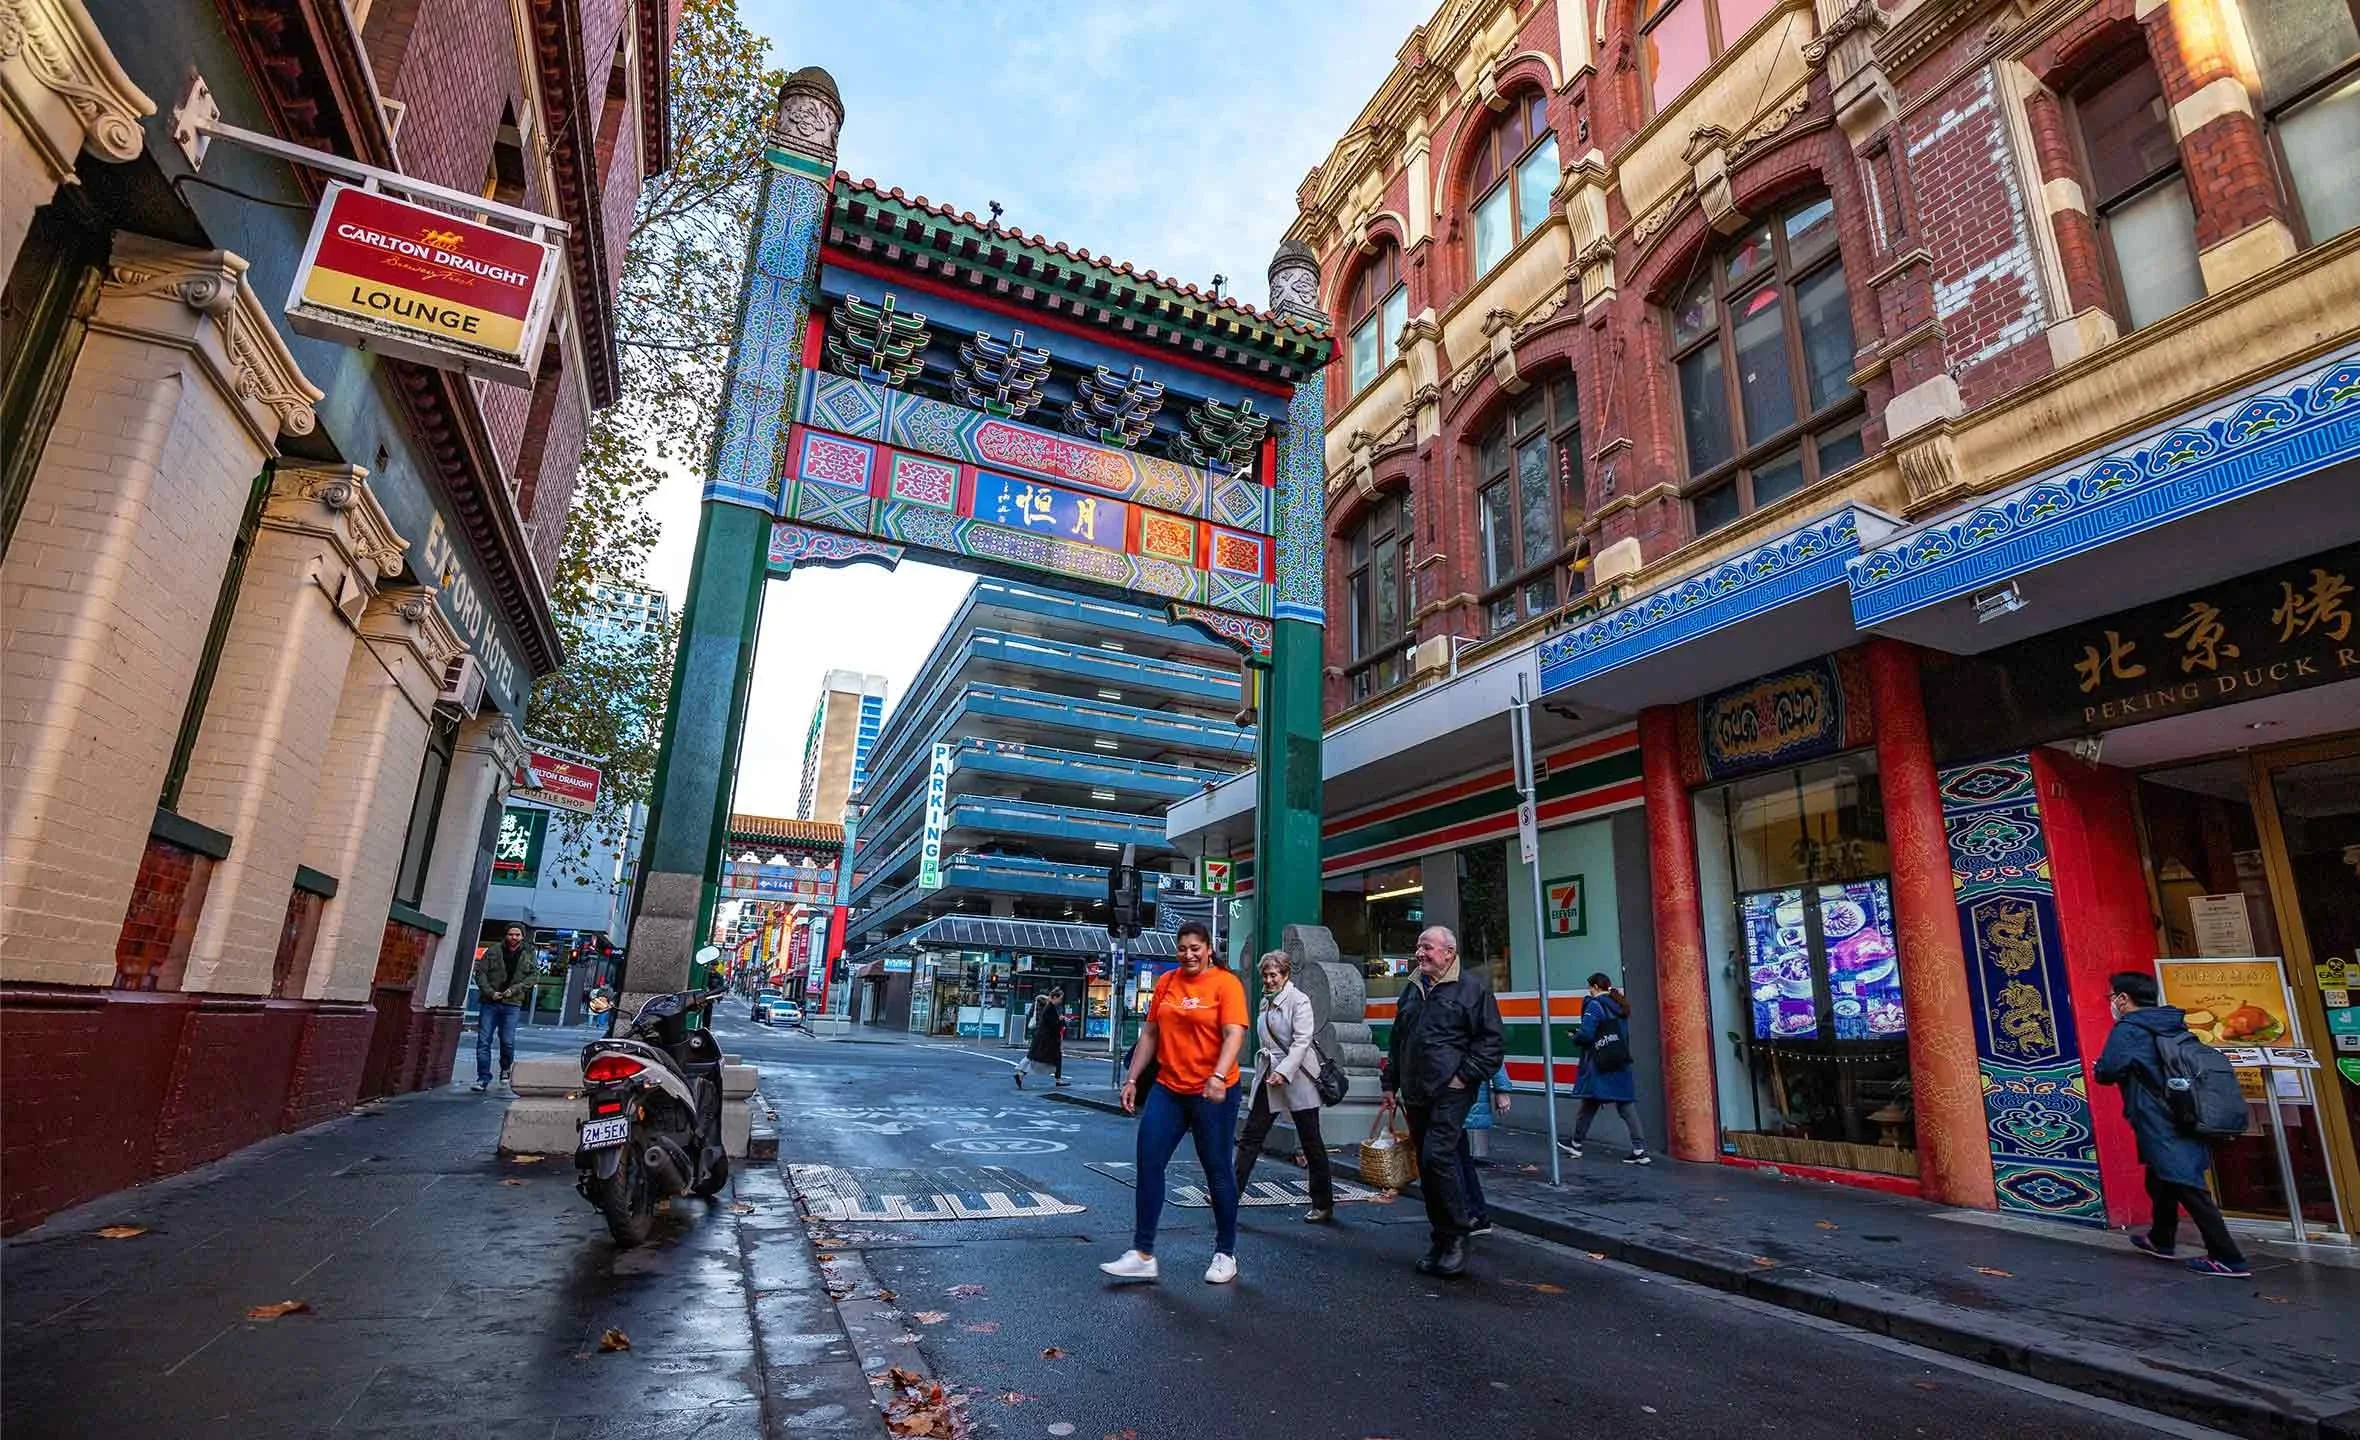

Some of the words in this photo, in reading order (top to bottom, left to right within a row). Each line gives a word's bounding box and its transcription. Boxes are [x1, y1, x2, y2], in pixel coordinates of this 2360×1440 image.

[337, 224, 430, 260] CARLTON
[434, 250, 529, 287] DRAUGHT
[351, 286, 481, 334] LOUNGE
[480, 615, 514, 701] HOTEL
[2083, 682, 2200, 723] PEKING
[2216, 655, 2320, 694] DUCK
[524, 788, 559, 801] BOTTLE
[560, 796, 585, 808] SHOP
[558, 774, 593, 790] DRAUGHT
[925, 746, 946, 858] PARKING
